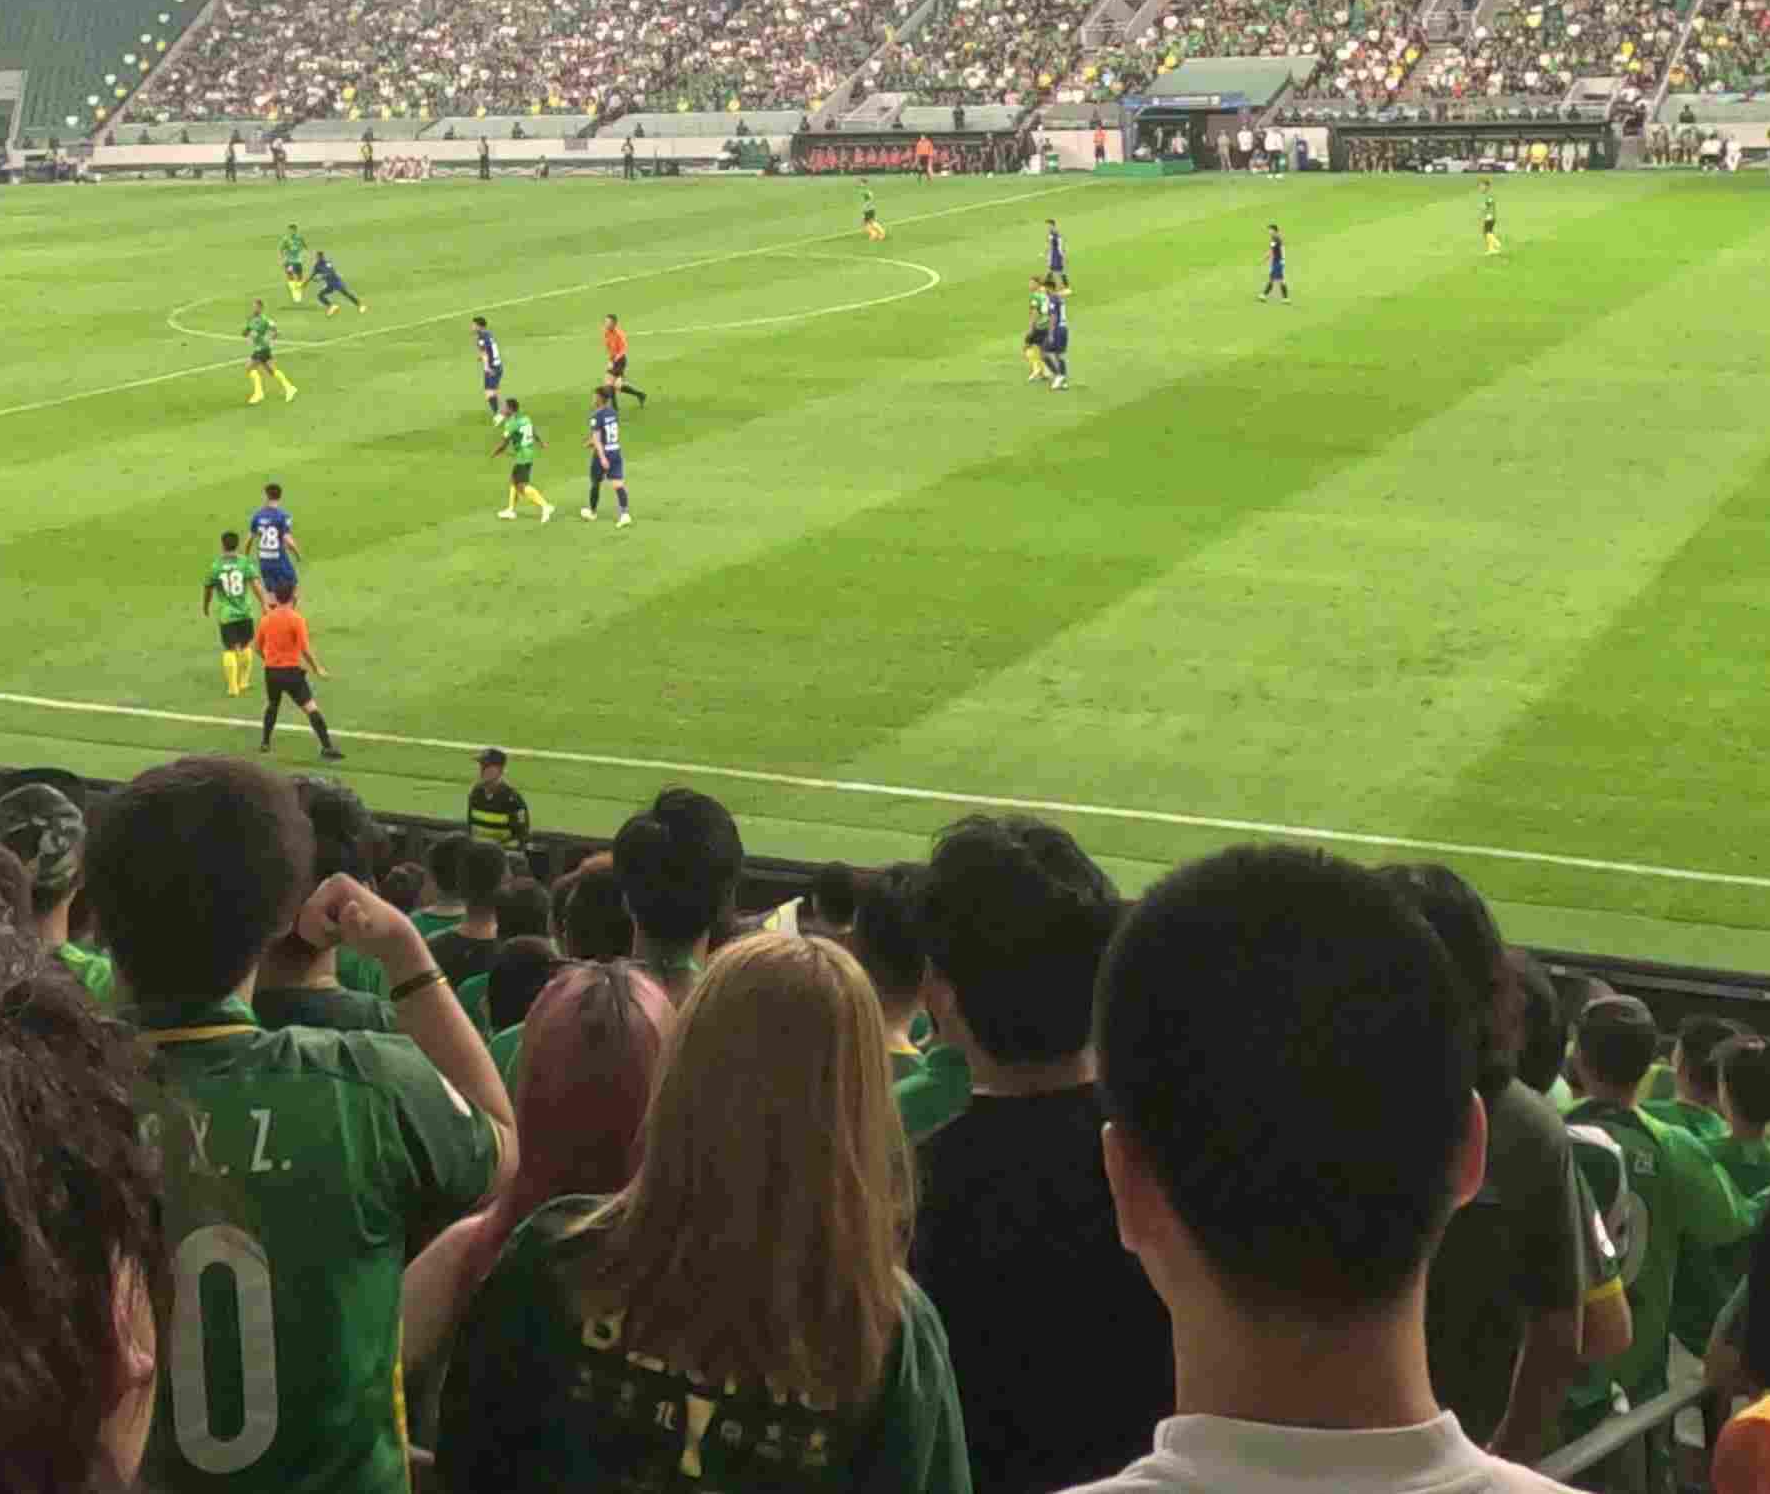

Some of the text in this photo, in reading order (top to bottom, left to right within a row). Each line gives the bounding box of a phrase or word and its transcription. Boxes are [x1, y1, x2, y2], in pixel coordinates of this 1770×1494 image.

[258, 526, 279, 549] 28
[219, 570, 244, 596] 18
[250, 1108, 292, 1173] Z.
